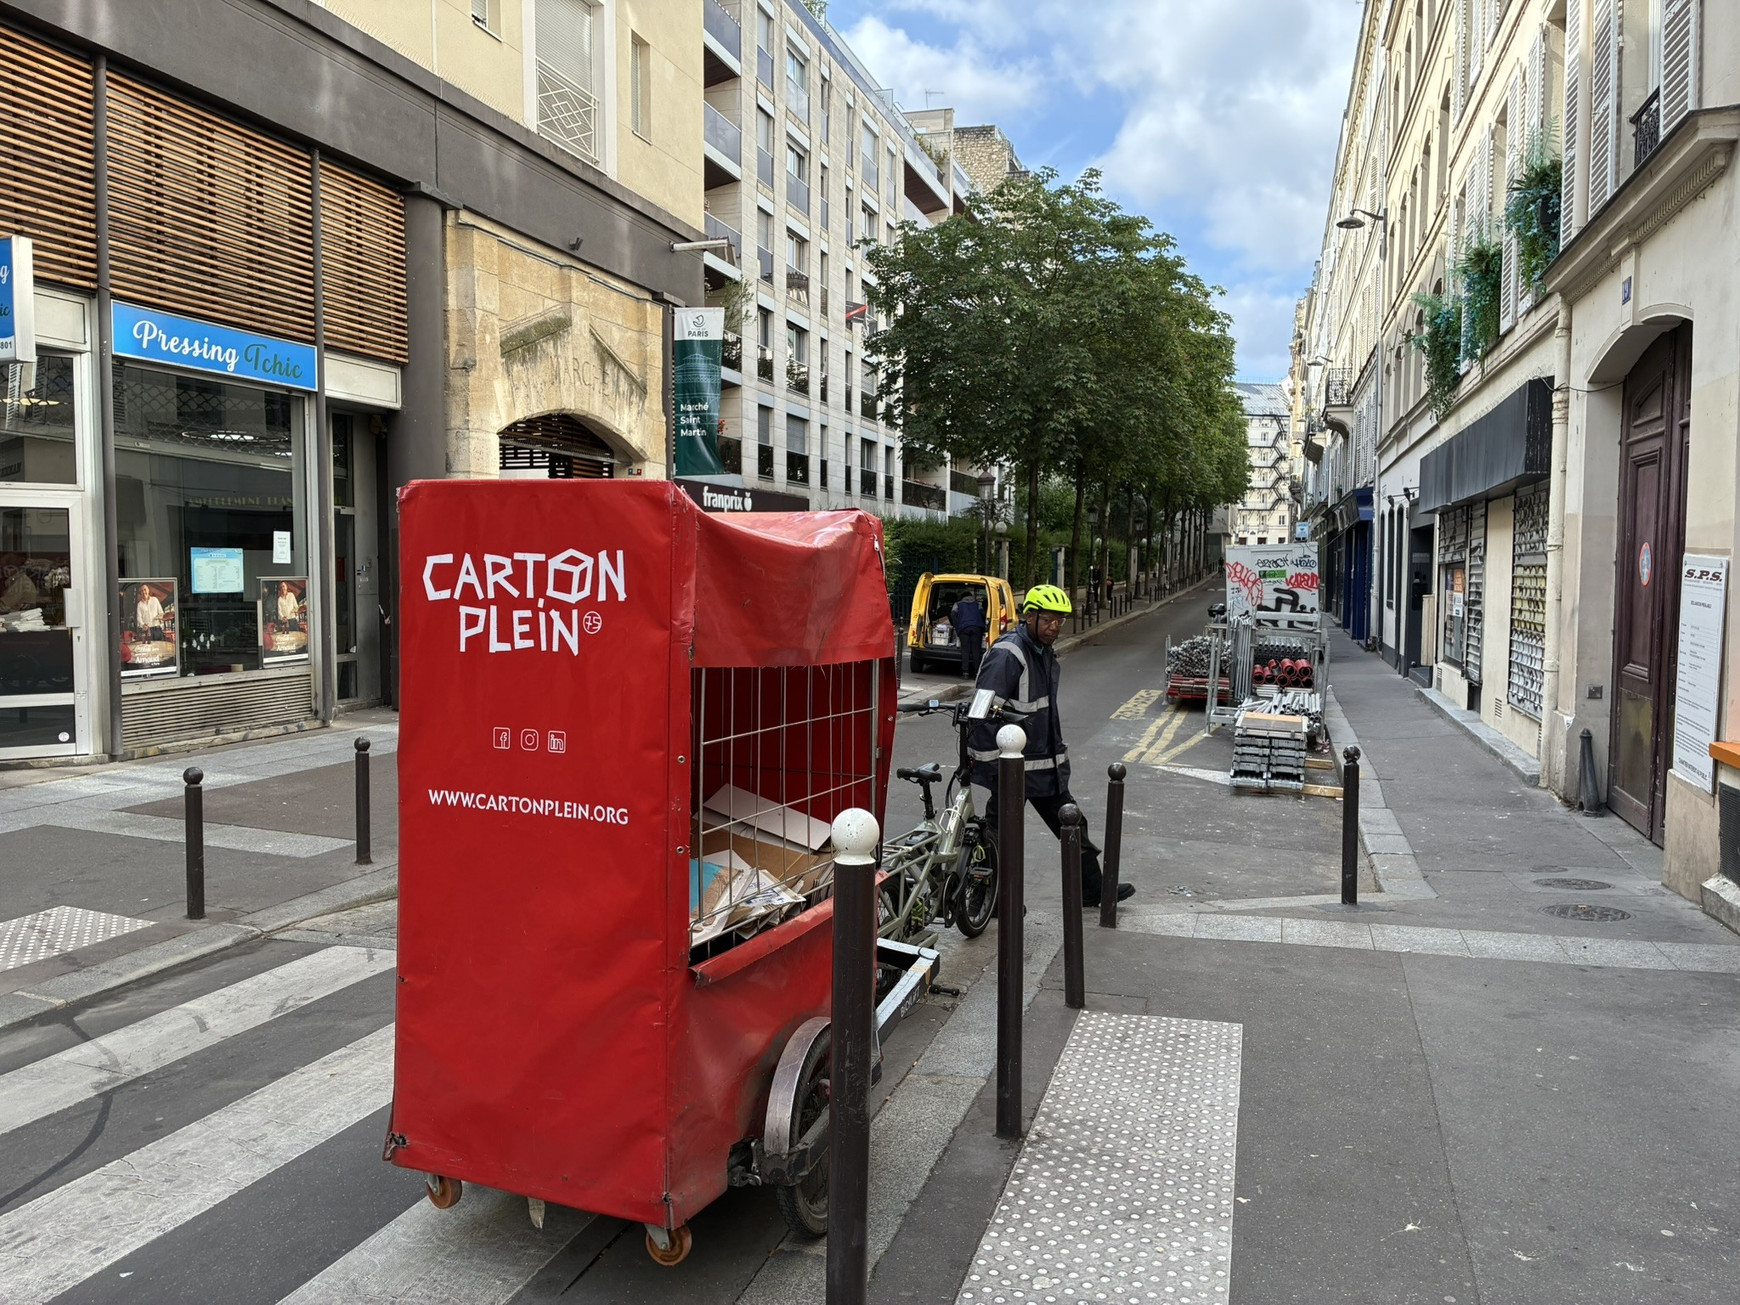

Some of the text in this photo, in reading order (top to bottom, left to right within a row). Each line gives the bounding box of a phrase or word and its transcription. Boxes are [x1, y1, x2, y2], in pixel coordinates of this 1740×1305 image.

[0, 341, 12, 350] 801
[133, 320, 302, 379] Pressing Tchic
[680, 402, 708, 411] Marché
[680, 415, 700, 424] Saint
[680, 428, 707, 437] Martin
[703, 485, 743, 513] franprix
[422, 548, 627, 604] CARTON
[1684, 568, 1722, 582] S.P.S.
[428, 789, 629, 825] WWW.CARTONPLEIN.ORG
